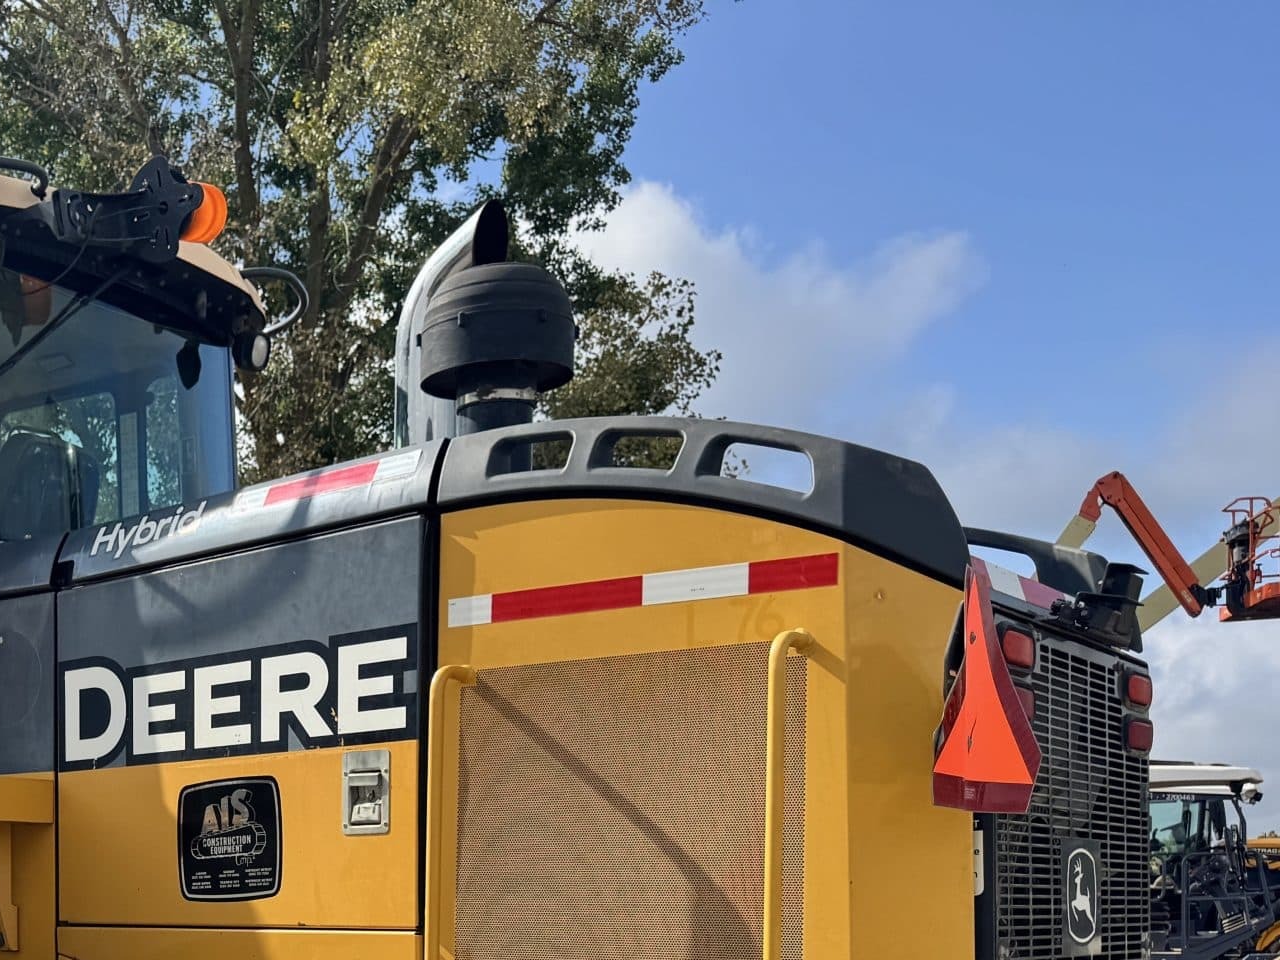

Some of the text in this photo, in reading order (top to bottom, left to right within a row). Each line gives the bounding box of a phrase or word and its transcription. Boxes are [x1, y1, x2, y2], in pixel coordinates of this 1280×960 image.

[90, 500, 208, 560] Hybrid
[64, 636, 408, 763] DEERE
[202, 834, 252, 848] CONSTRUCTION
[210, 844, 243, 855] EQUIPMENT
